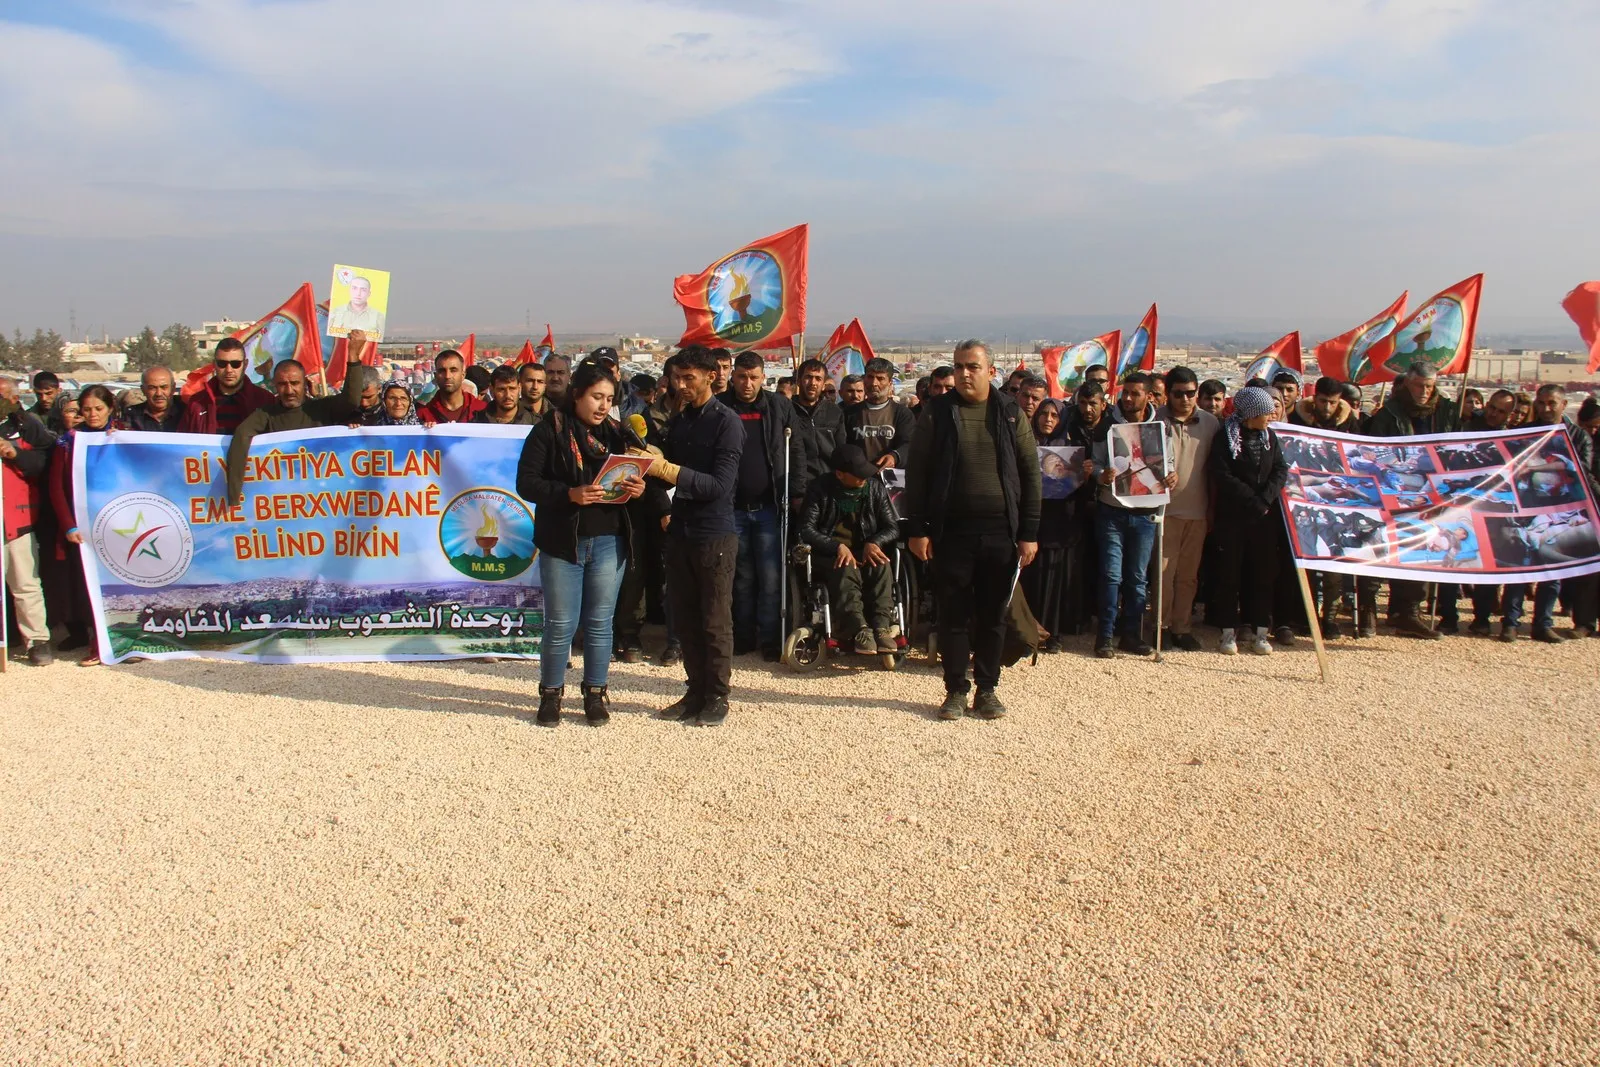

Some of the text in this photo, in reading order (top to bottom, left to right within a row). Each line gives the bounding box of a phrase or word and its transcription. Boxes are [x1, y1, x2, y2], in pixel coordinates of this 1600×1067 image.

[350, 449, 441, 478] GELAN
[254, 483, 441, 521] BERXWEDANÊ
[234, 523, 400, 560] BİLİND BİKİN
[471, 562, 506, 574] M.M.Ş
[142, 607, 233, 639] المقاومة
[338, 601, 444, 638] الشعوب
[450, 603, 525, 636] بوحدة
